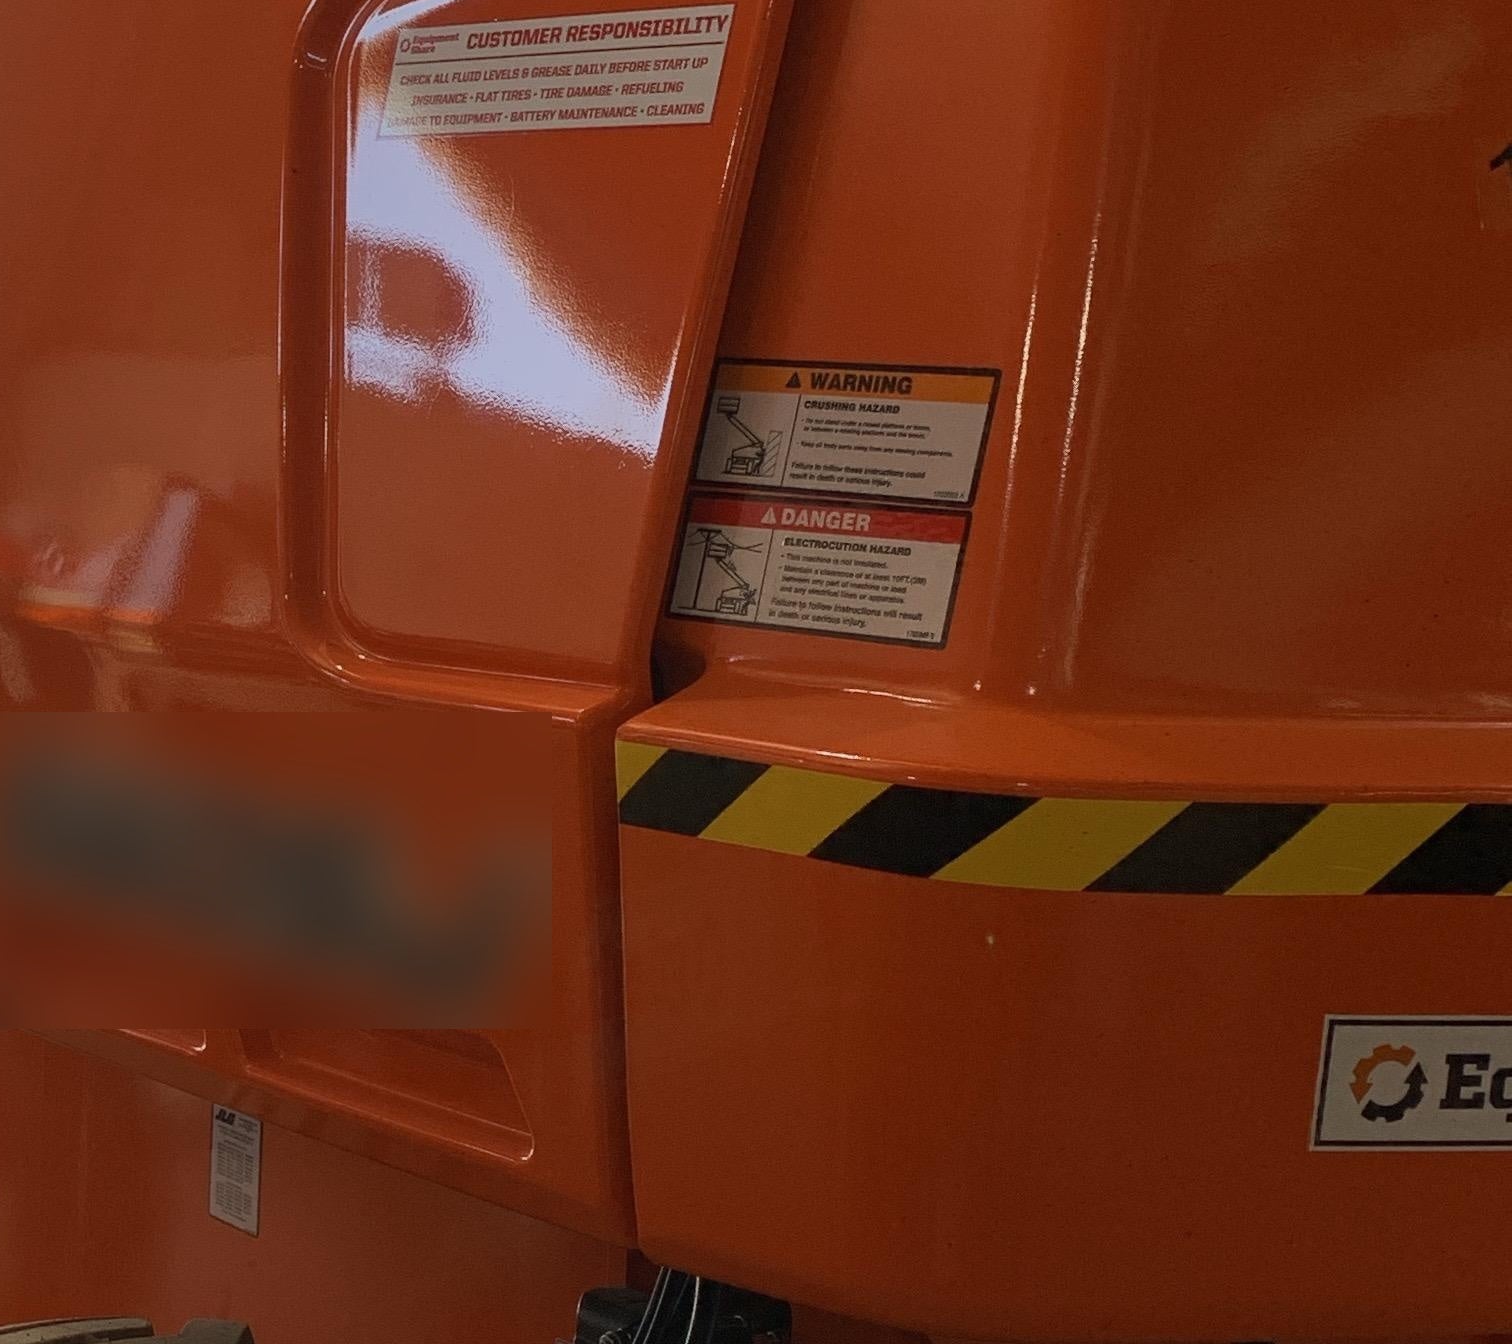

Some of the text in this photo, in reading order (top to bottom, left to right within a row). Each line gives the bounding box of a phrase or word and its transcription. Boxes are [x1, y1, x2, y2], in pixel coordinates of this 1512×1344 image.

[467, 15, 728, 49] CUSTOMER RESPONSIBILITY
[400, 58, 708, 85] CHECK ALL FLUID LEVELS & GREASE DAILY BEFORE START UP
[413, 82, 684, 106] INSURANCE FLAT TIRES TIRE DAMAGE REFUELING
[430, 115, 440, 125] TO
[443, 112, 503, 125] EQUIPMENT
[510, 109, 556, 122] BATTERY
[558, 106, 637, 120] MAINTENANCE
[647, 103, 704, 116] CLEANING
[810, 372, 913, 395] WARNING
[804, 401, 900, 414] CRUSHING HAZARD
[781, 508, 871, 532] DANGER
[784, 538, 911, 556] ELECTROCUTION HAZARD
